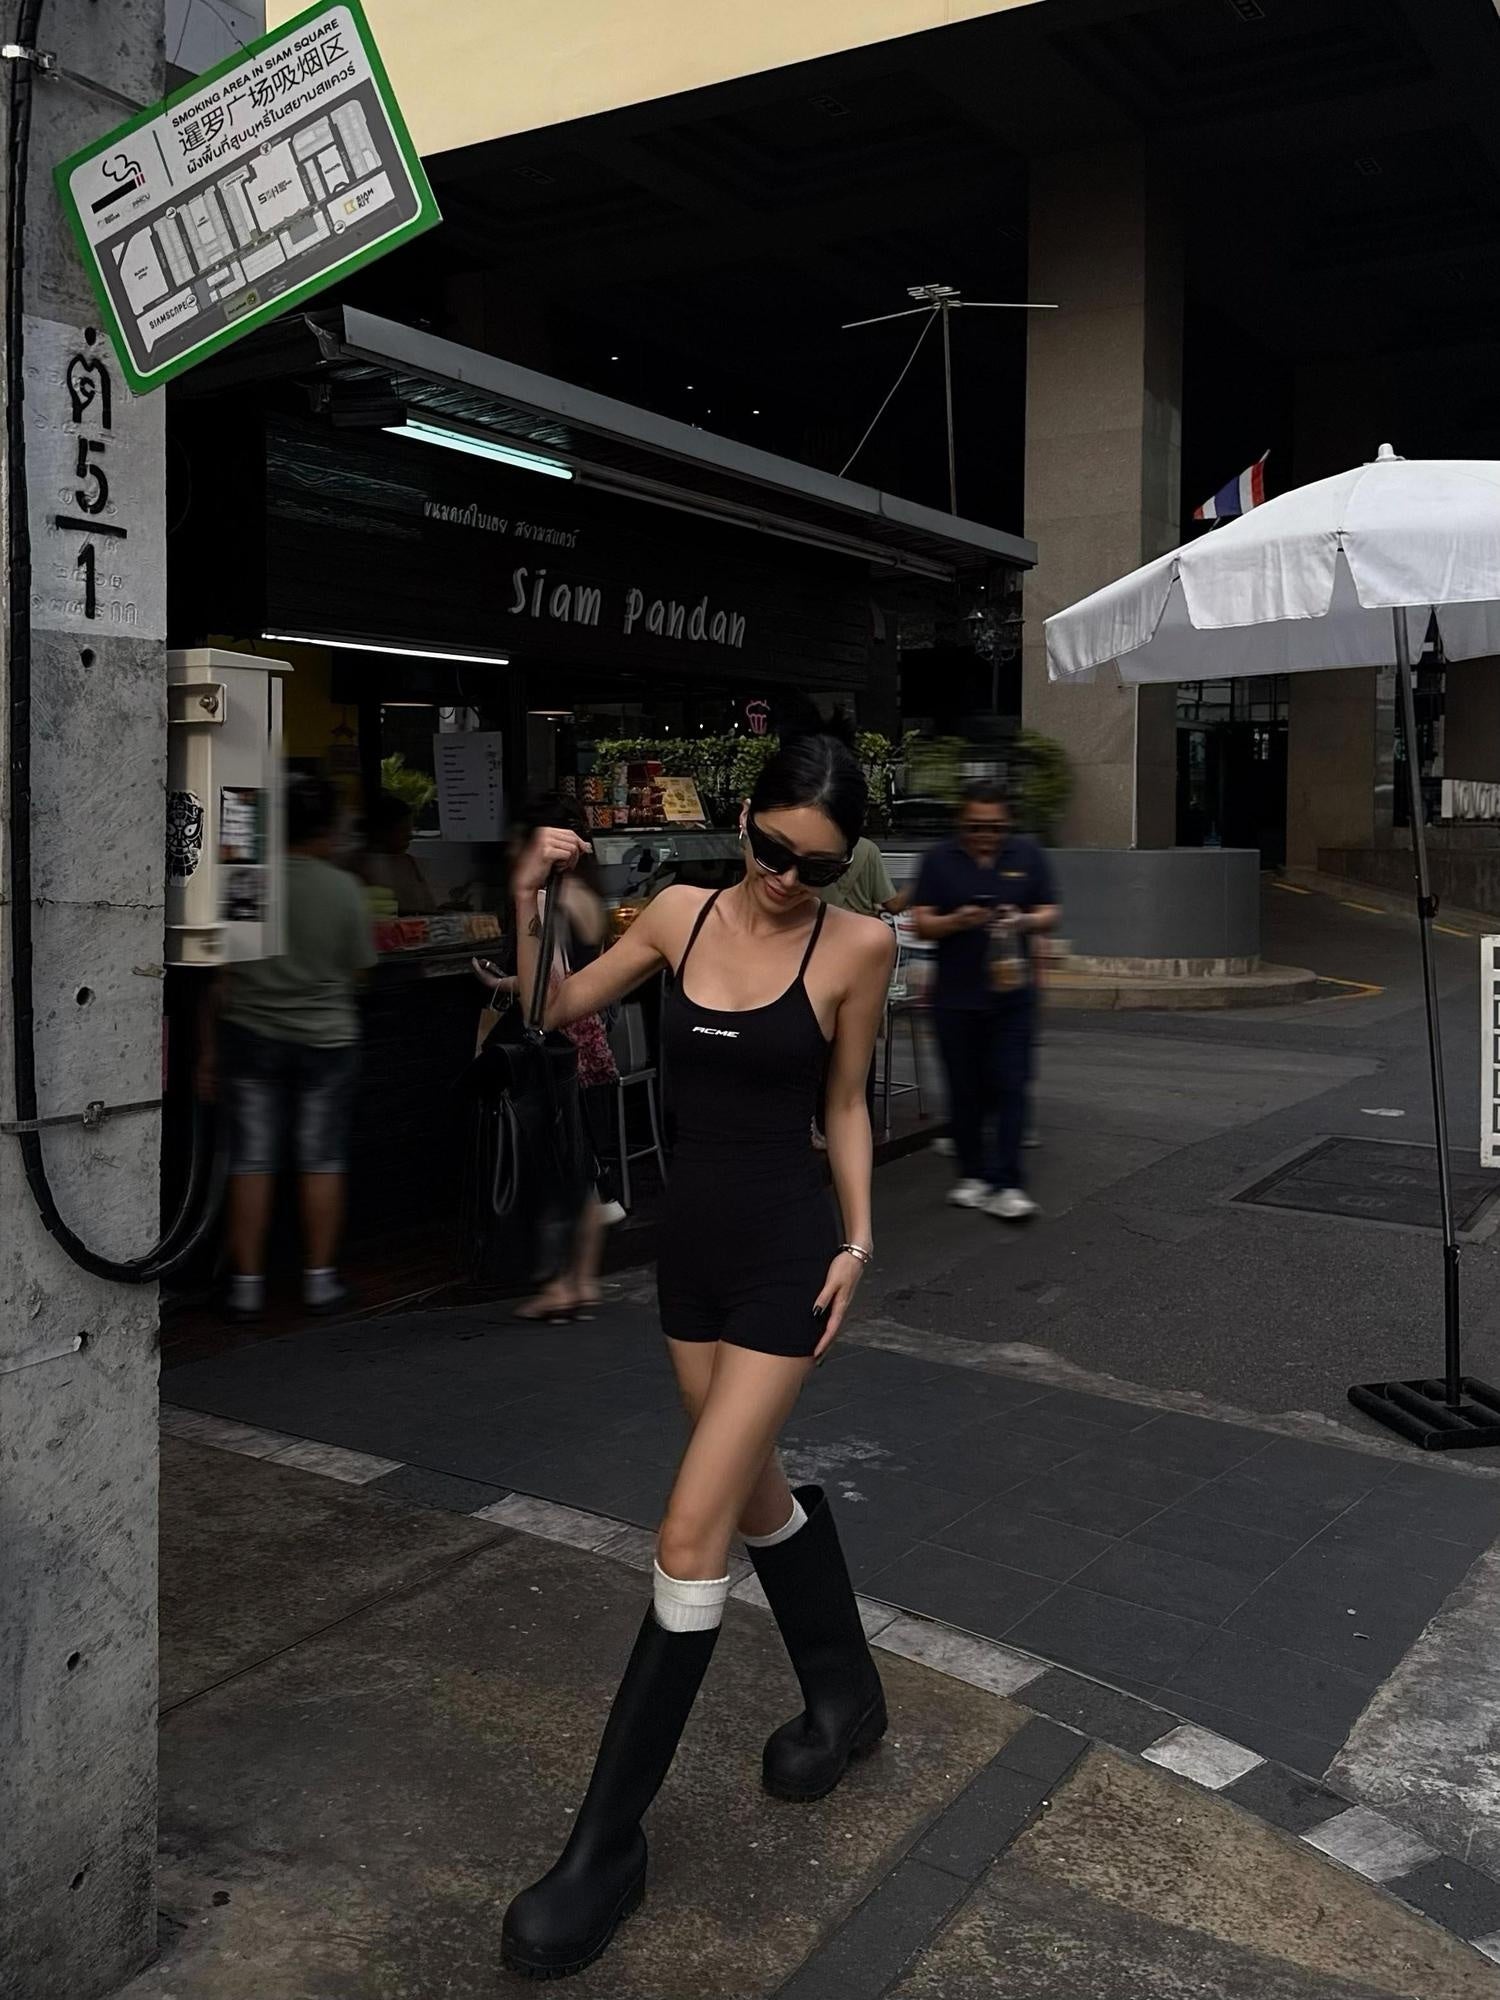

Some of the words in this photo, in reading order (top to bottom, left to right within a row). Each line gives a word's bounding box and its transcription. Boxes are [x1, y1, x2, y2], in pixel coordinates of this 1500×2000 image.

[172, 92, 221, 128] SMOKING
[223, 74, 252, 98] AREA
[252, 65, 264, 79] IN
[265, 47, 293, 71] SIAM
[294, 18, 340, 52] SQUARE
[177, 32, 350, 156] 暹罗广场吸烟区
[187, 61, 356, 175] ผังพื้นที่สูบบุหรี่ในสยามสแควร์
[356, 188, 375, 204] SIAM
[358, 196, 370, 209] KIT
[149, 300, 189, 330] SIAMSCAPE
[507, 566, 602, 627] Siam
[692, 1026, 740, 1038] ACME
